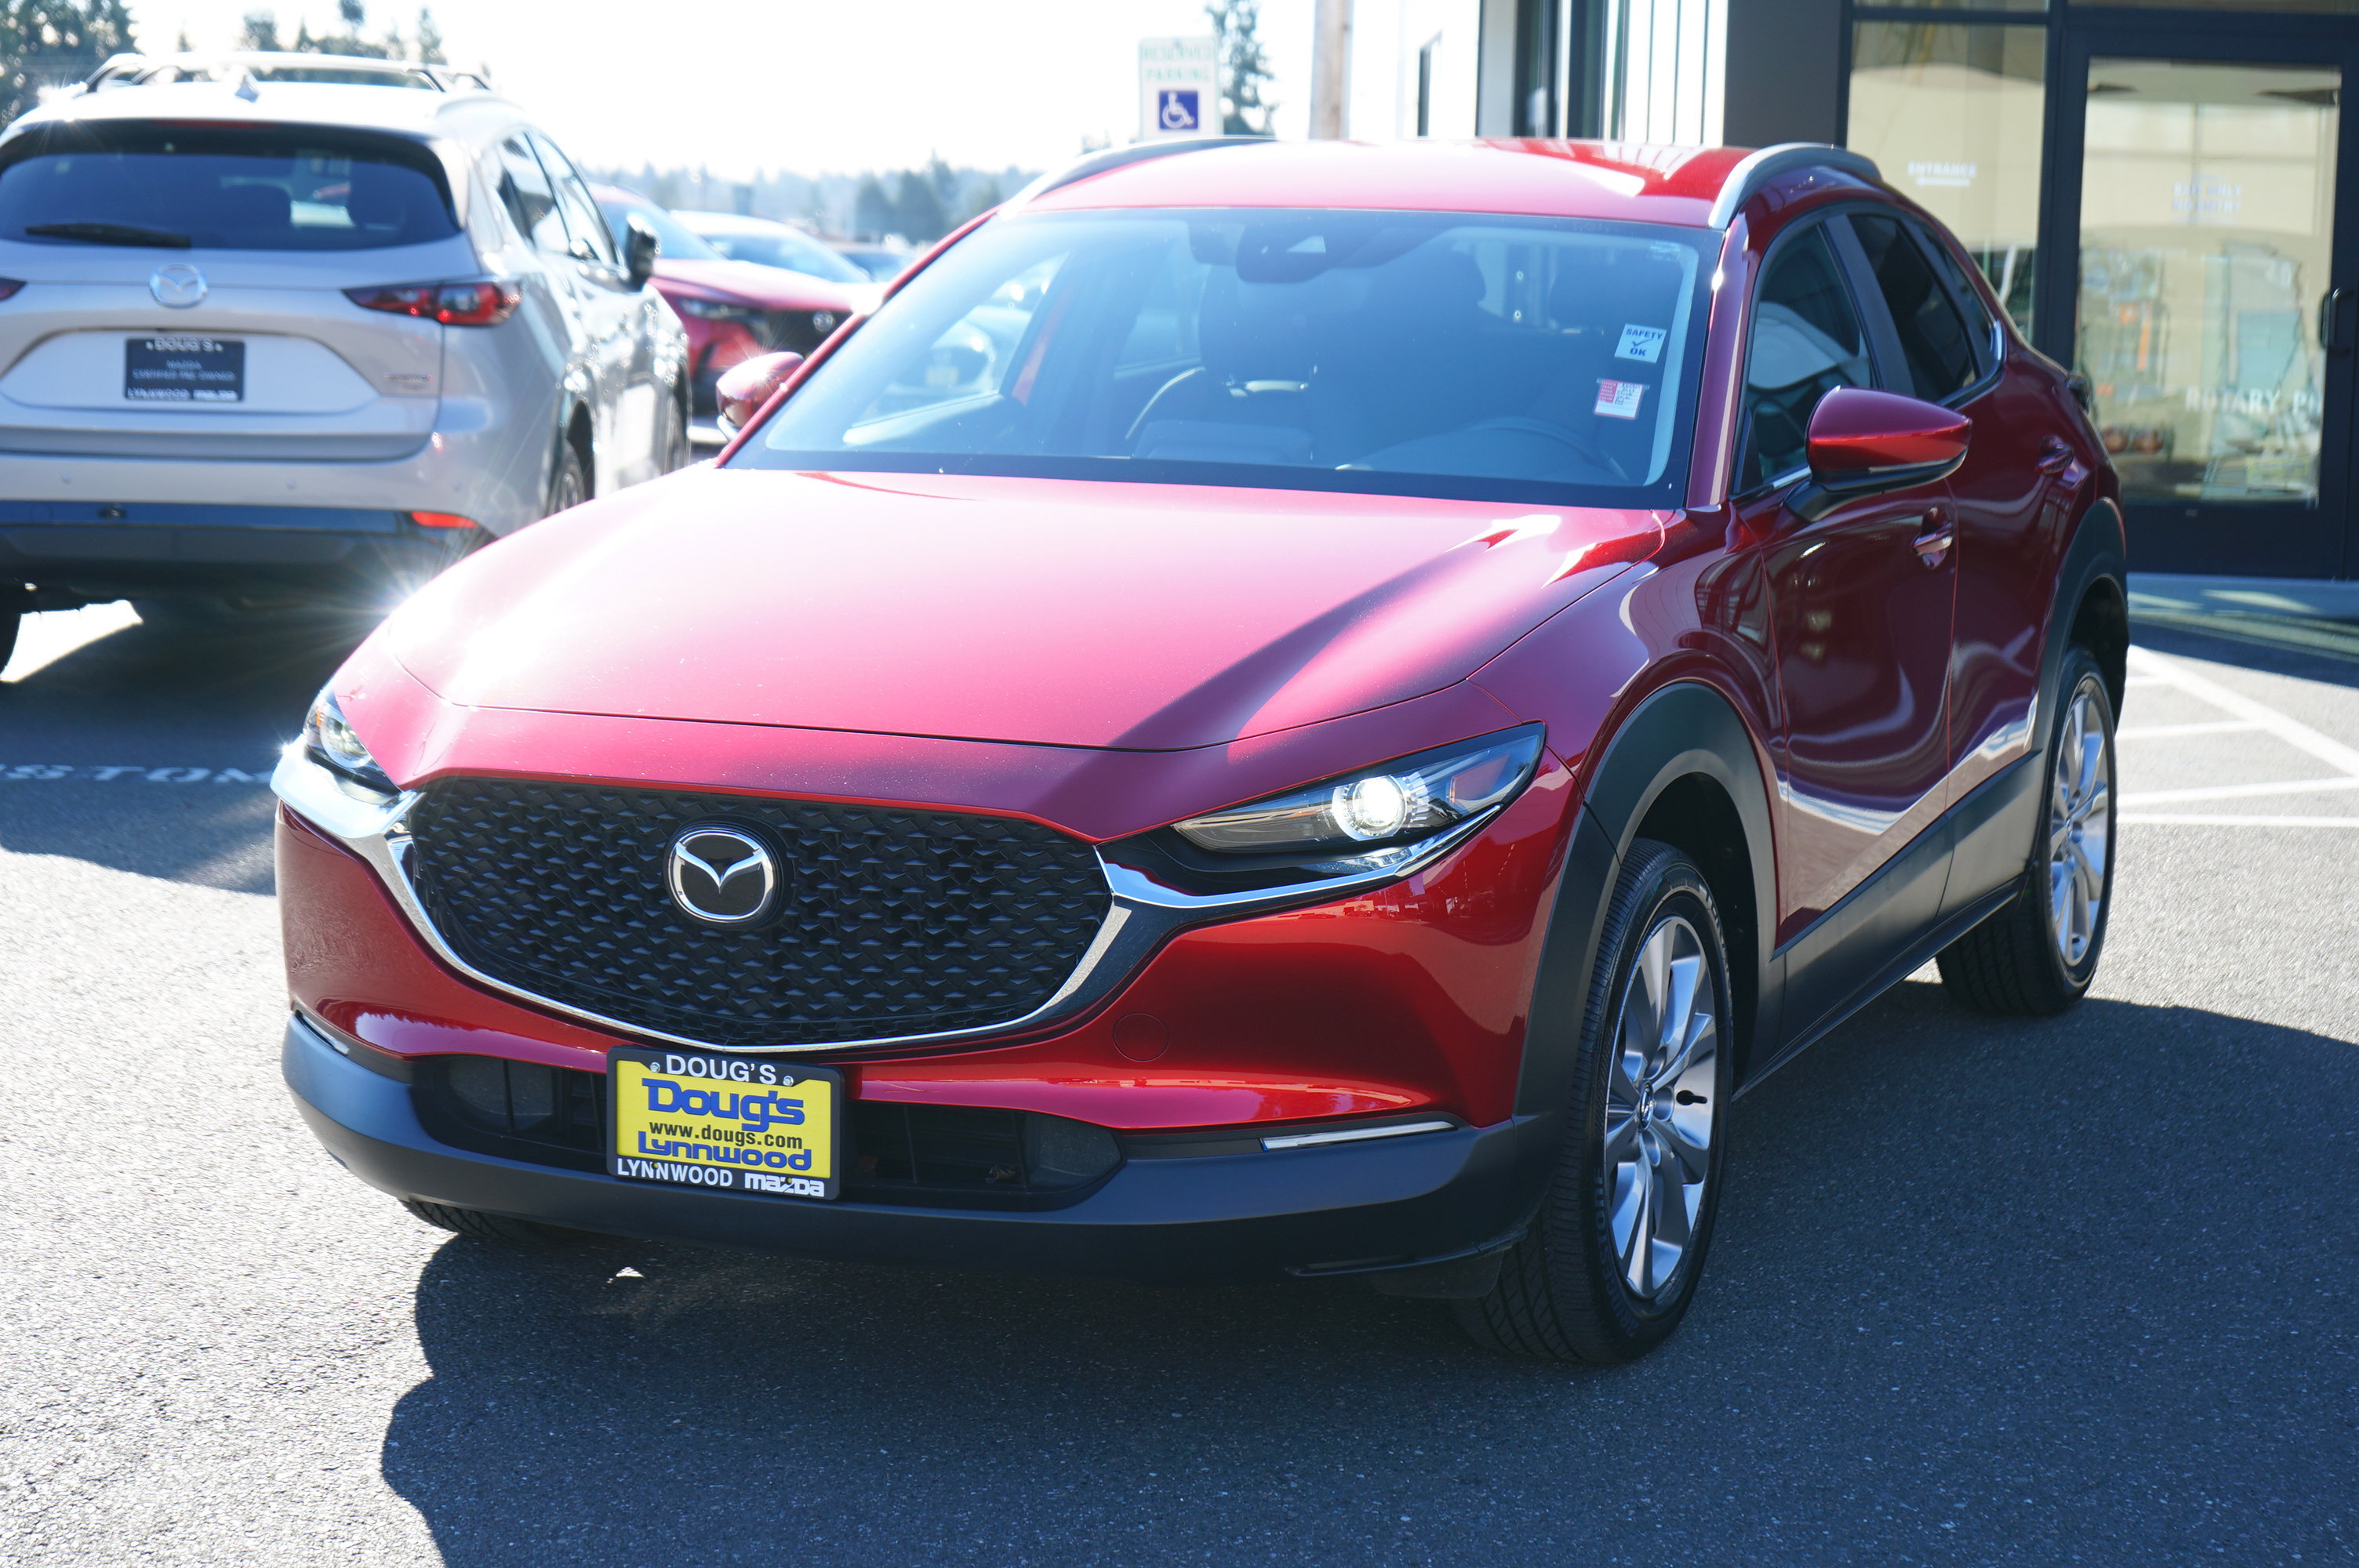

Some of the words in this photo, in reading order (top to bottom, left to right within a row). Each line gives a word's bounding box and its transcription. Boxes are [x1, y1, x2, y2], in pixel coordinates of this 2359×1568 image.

[1907, 162, 1977, 177] ENTRANCE
[154, 337, 215, 352] DOUG'S
[1626, 328, 1663, 339] SAFETY
[1630, 347, 1646, 357] OK
[2186, 387, 2281, 415] ROTARY
[666, 1054, 776, 1085] DOUG'S
[642, 1077, 805, 1132] Doug's
[649, 1121, 802, 1149] www.dougs.com
[638, 1131, 812, 1171] Lynnwood
[617, 1157, 732, 1187] LYNNWOOD
